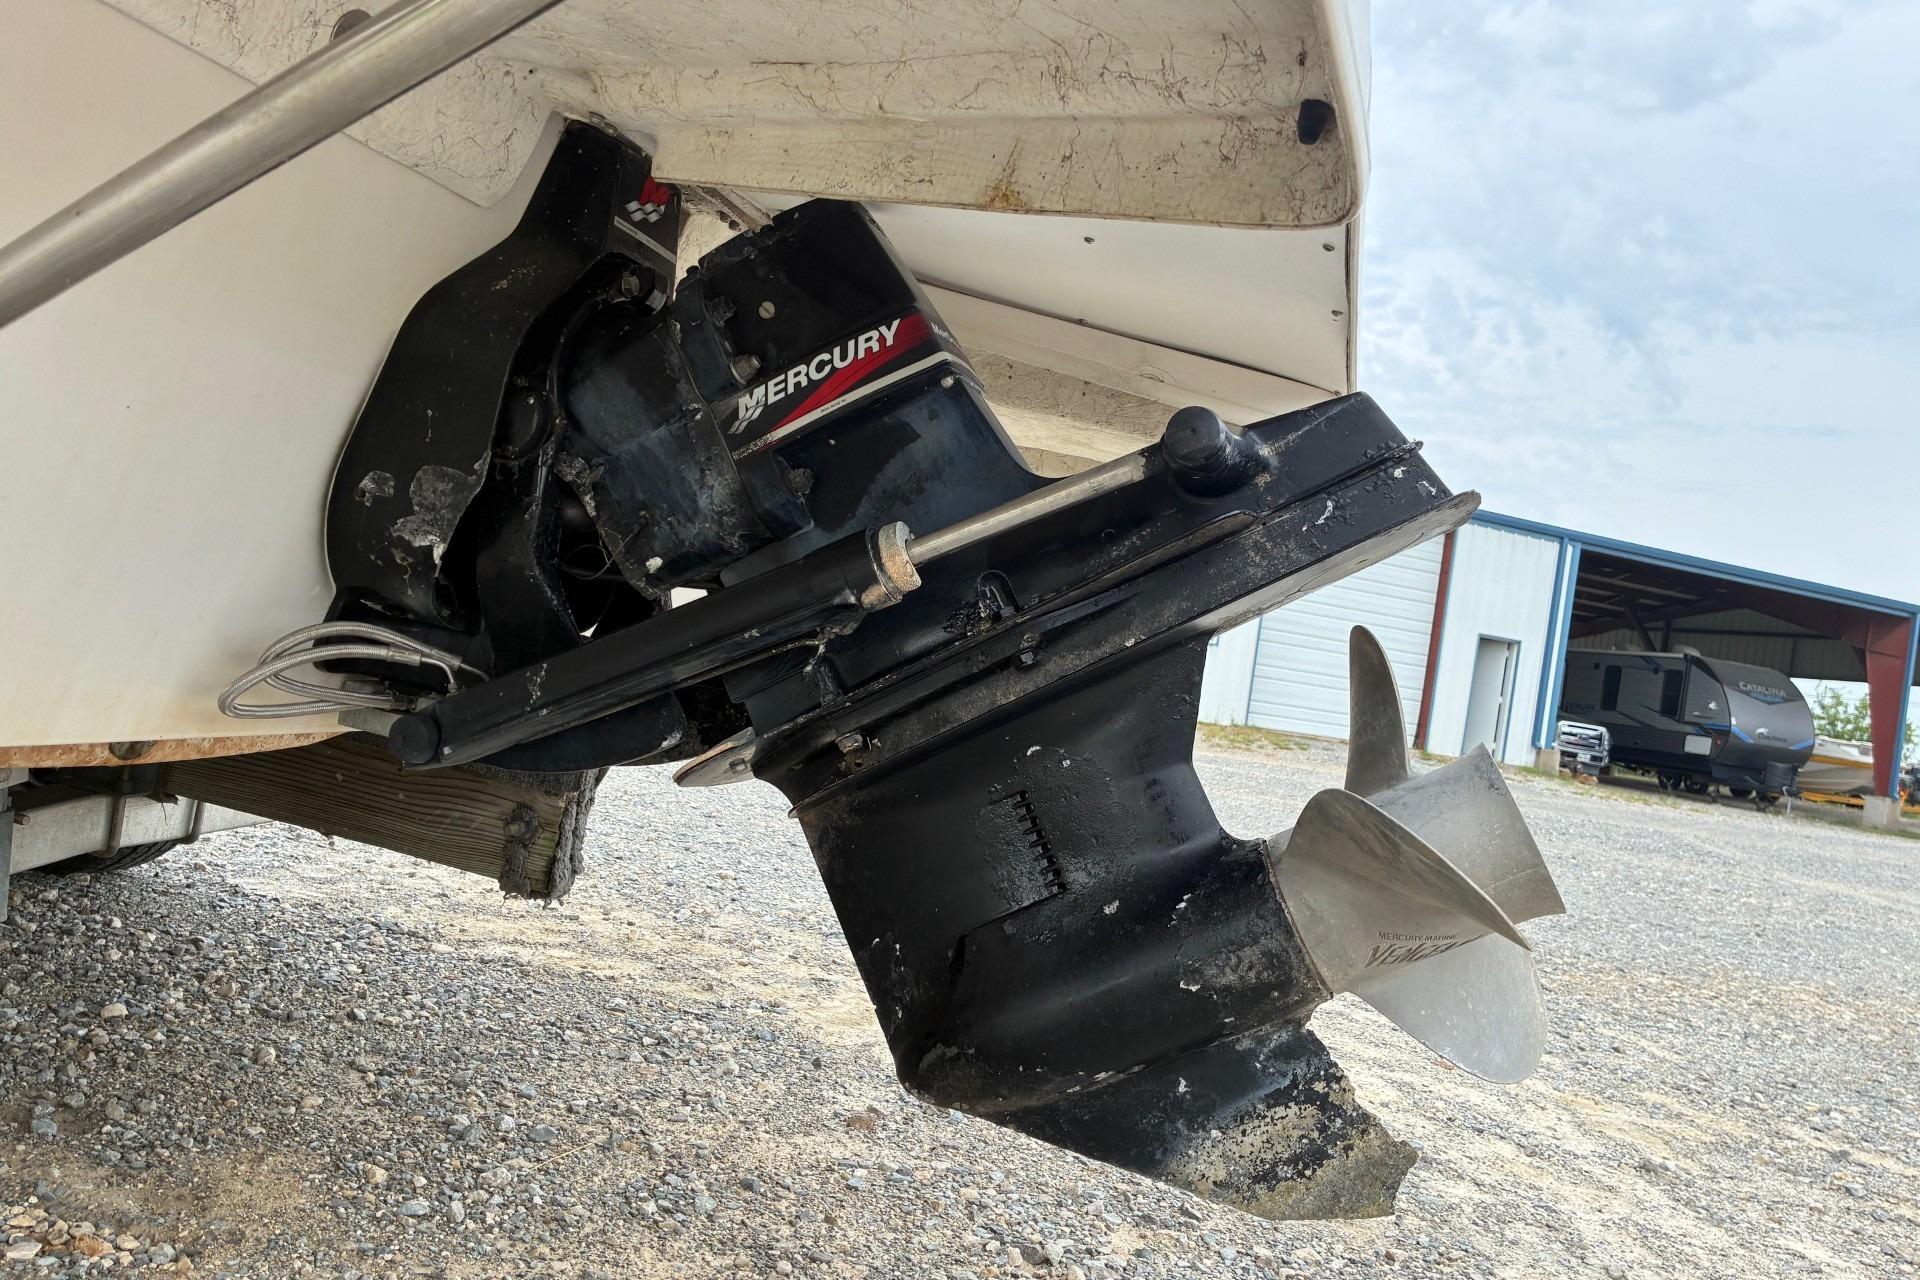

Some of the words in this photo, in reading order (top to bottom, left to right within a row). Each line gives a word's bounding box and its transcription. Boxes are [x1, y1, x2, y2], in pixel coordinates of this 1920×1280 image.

[730, 318, 901, 432] MERCURY
[1739, 681, 1786, 697] CATALINA
[1378, 930, 1422, 942] MERCURY
